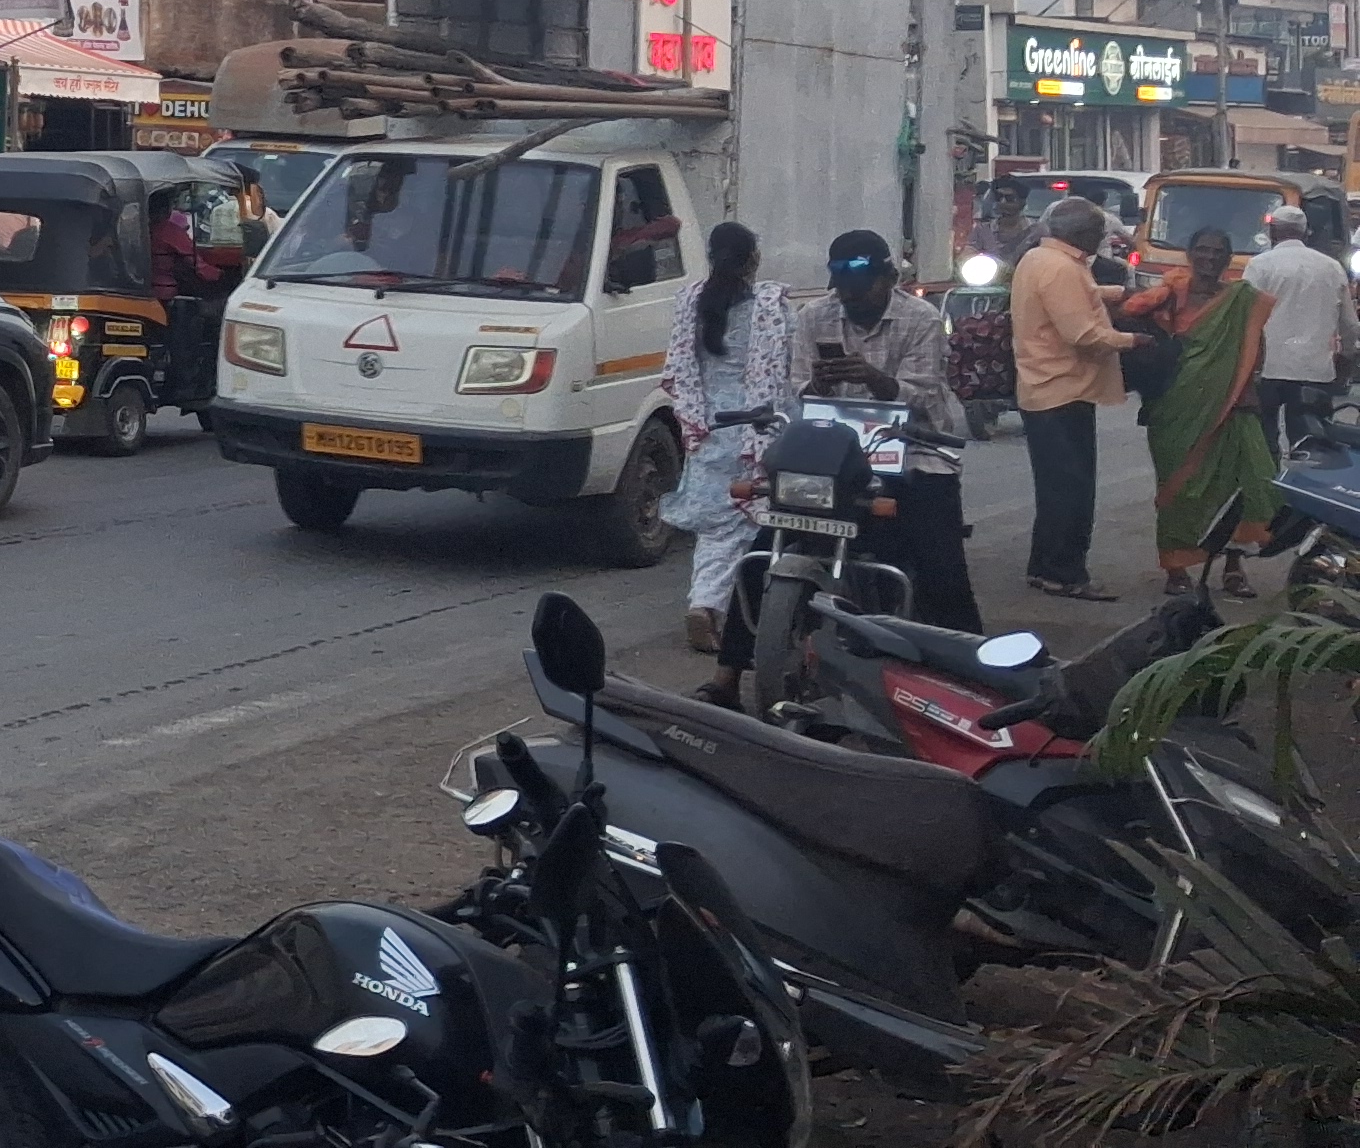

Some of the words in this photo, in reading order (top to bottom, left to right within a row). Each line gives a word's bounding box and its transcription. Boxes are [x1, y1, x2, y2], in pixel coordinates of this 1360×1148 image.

[1025, 36, 1097, 78] Greenline
[1129, 43, 1182, 86] ग्रीनलाईन
[351, 971, 430, 1017] HONDA
